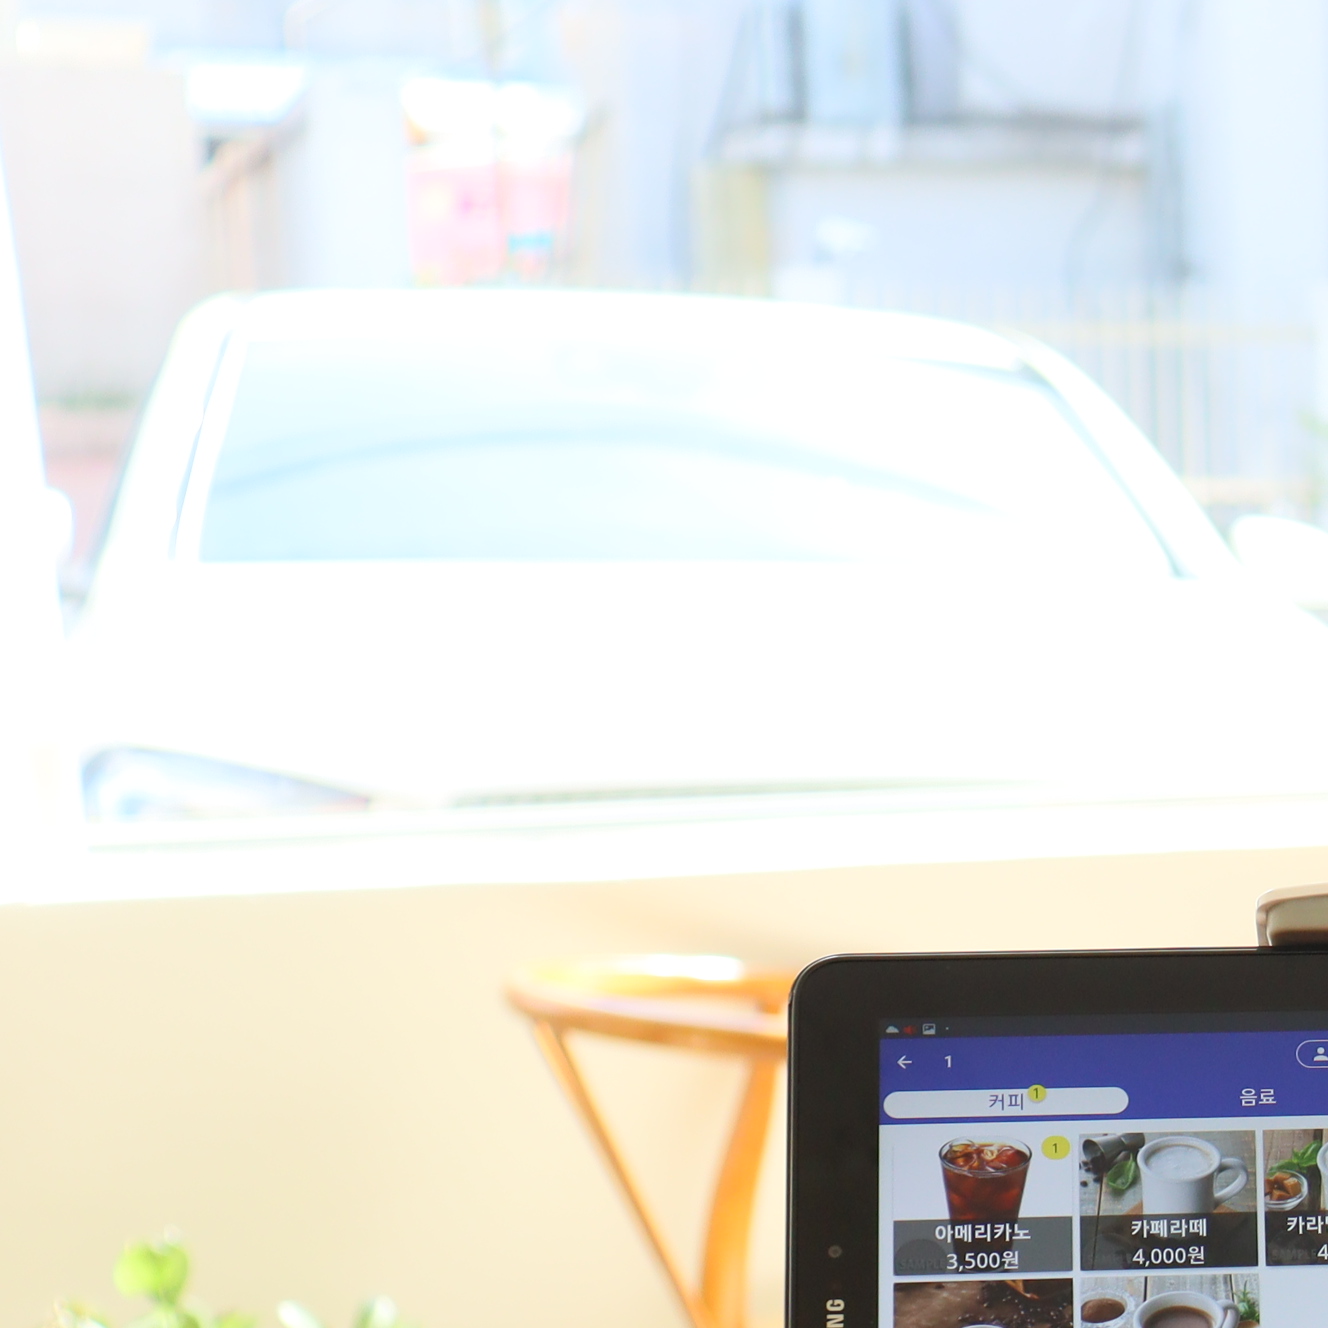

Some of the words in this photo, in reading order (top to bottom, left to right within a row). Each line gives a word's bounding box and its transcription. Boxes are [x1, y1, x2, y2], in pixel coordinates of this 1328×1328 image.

[944, 1055, 952, 1069] 1
[988, 1093, 1025, 1111] 커피
[1033, 1087, 1040, 1099] 1
[1240, 1087, 1277, 1107] 음료
[1052, 1142, 1059, 1154] 1
[935, 1223, 1032, 1243] 아메리카노
[1131, 1218, 1208, 1239] 카페라떼
[945, 1250, 1020, 1271] 3,500원
[1132, 1246, 1206, 1267] 4,000원
